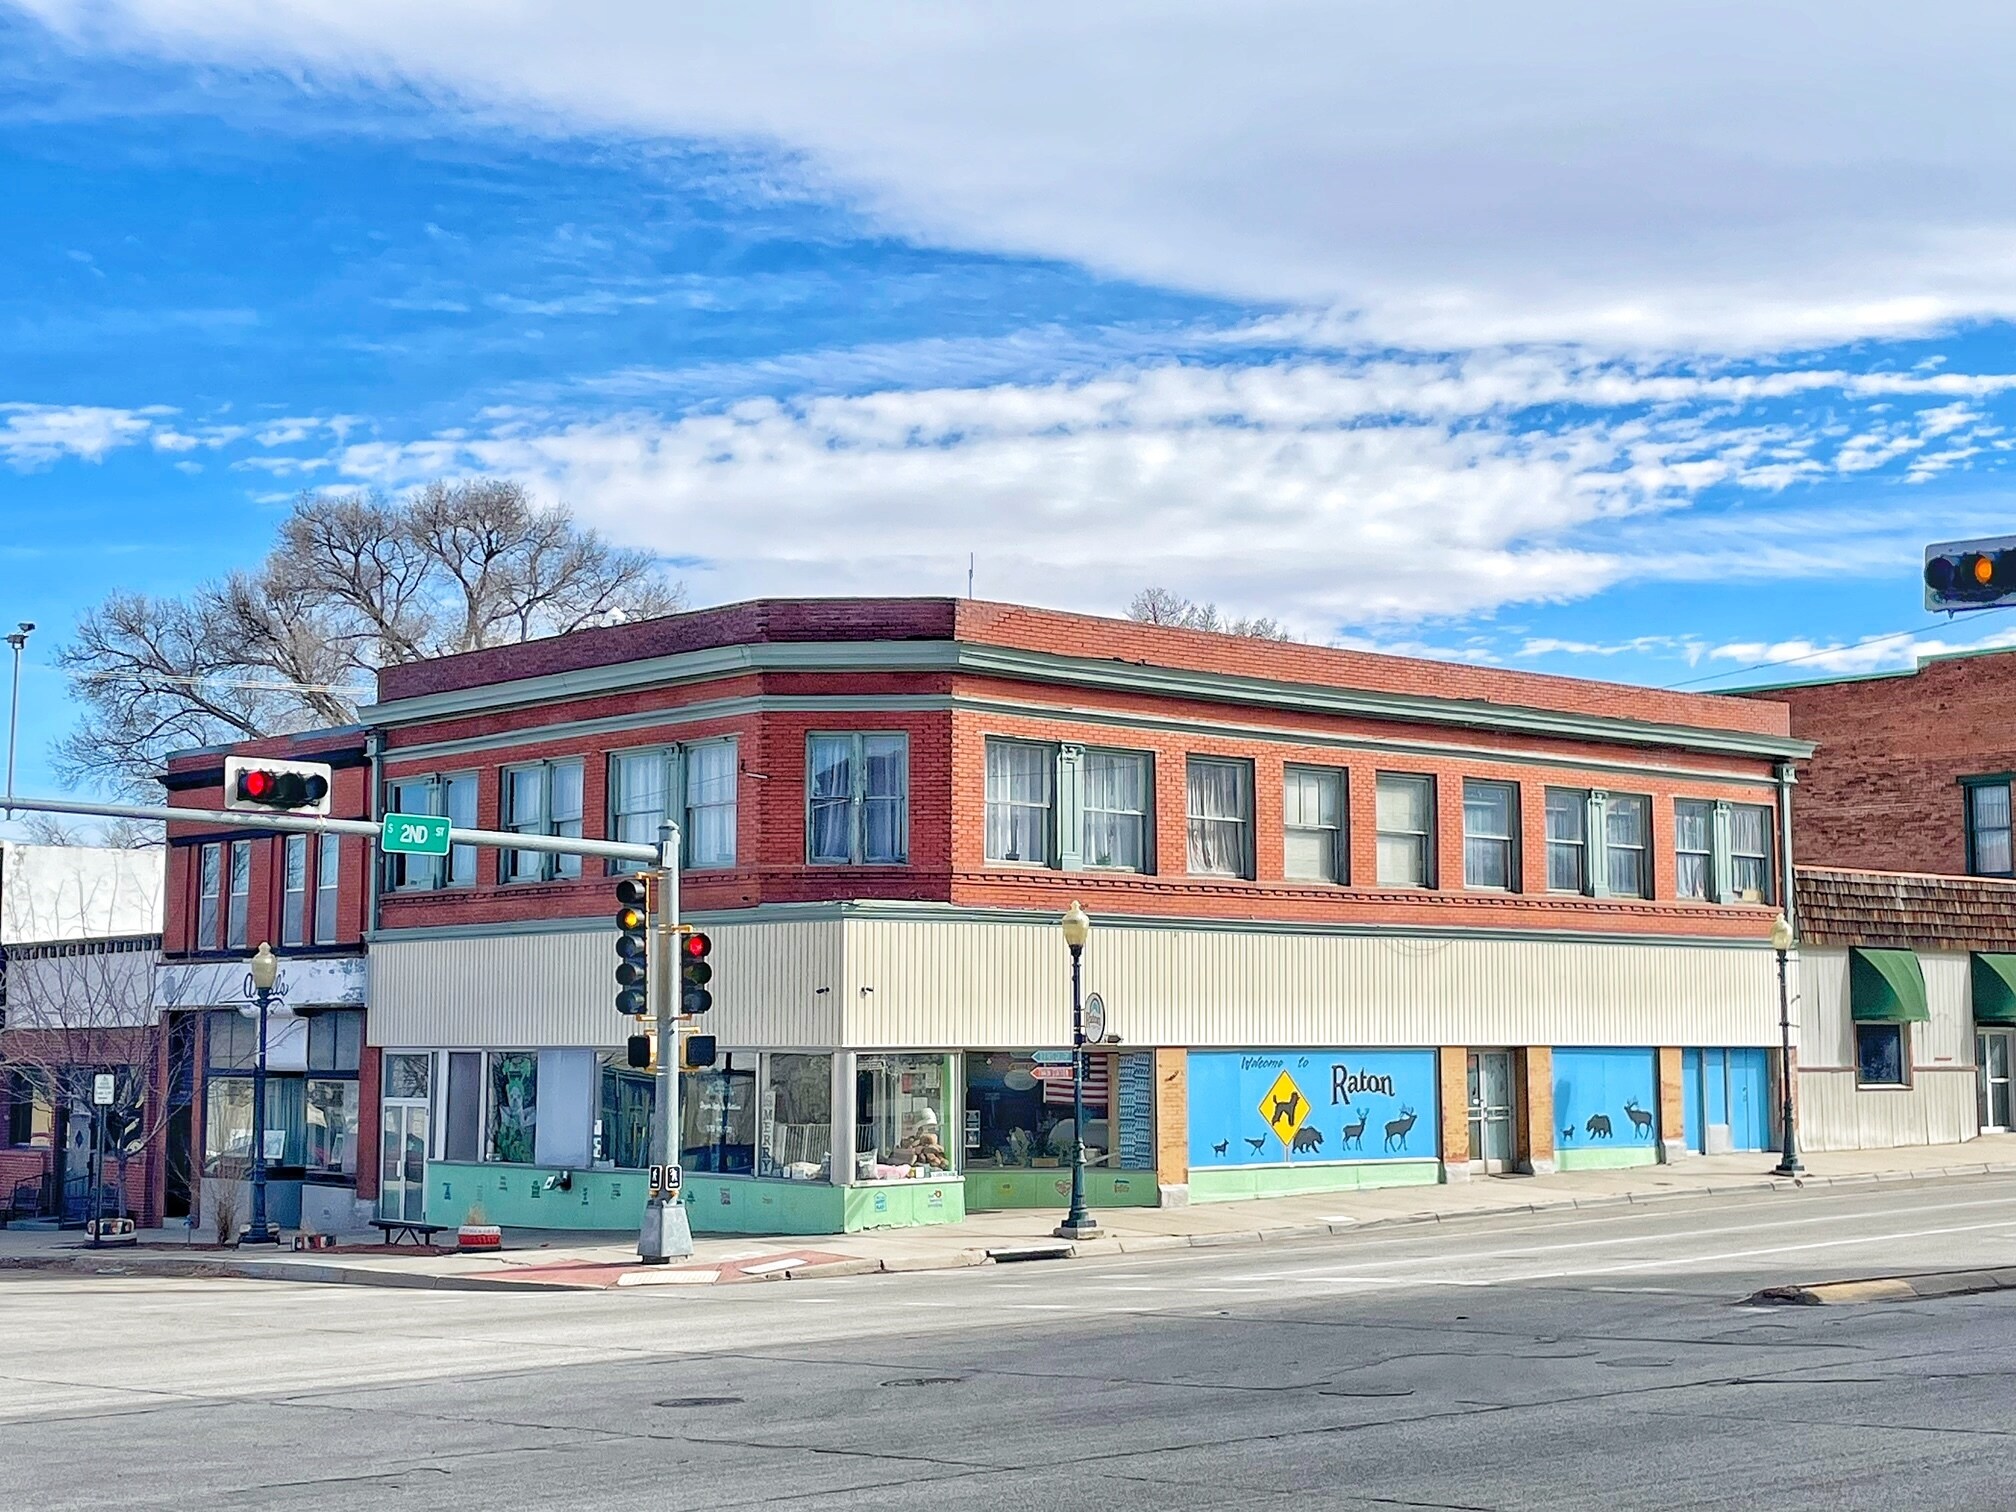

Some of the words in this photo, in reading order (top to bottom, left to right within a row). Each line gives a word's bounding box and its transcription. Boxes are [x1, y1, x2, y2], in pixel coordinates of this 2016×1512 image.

[387, 823, 394, 834] S
[400, 823, 428, 844] 2ND
[435, 827, 445, 837] ST
[1241, 1056, 1284, 1071] Welcome
[1297, 1056, 1309, 1068] to
[1331, 1064, 1395, 1106] Raton
[761, 1109, 774, 1172] MERRY
